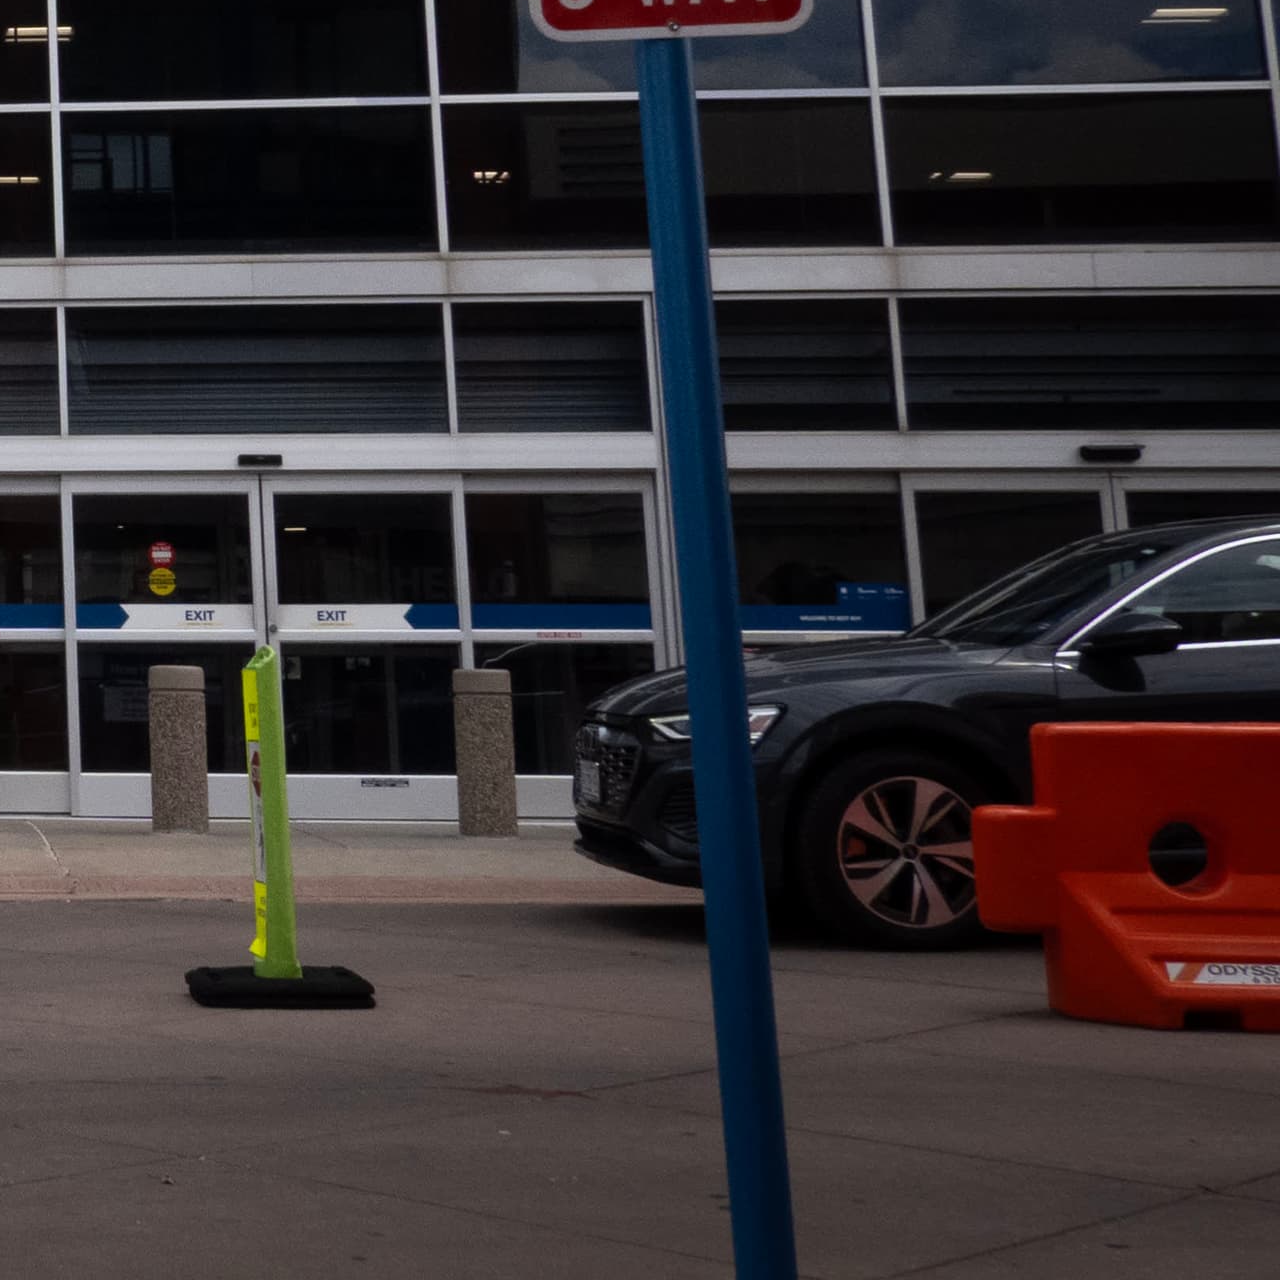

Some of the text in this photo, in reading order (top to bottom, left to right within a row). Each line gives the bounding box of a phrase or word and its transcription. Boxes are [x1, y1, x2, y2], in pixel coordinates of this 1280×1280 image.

[185, 610, 215, 621] EXIT
[317, 610, 347, 621] EXIT
[1208, 965, 1280, 977] ODYSS
